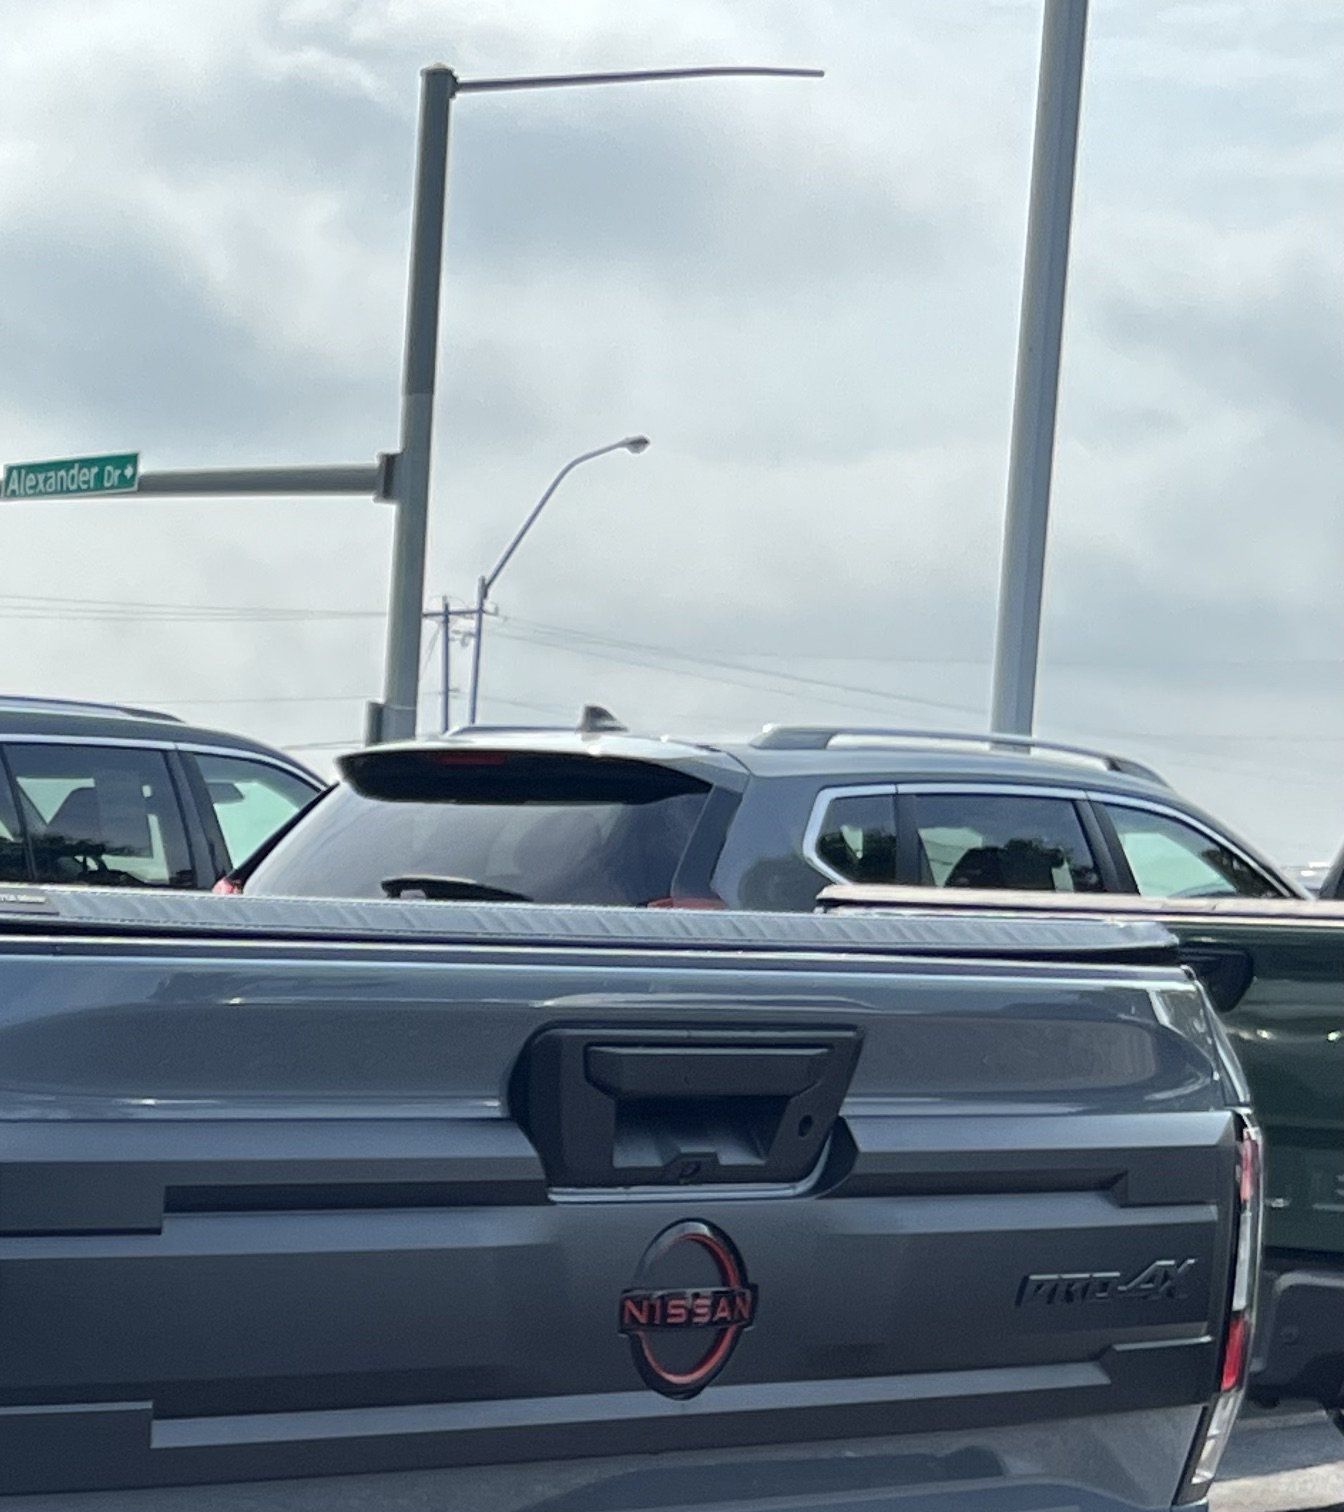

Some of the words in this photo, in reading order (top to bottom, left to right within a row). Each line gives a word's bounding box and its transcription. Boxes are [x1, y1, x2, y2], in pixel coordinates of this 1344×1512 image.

[7, 462, 99, 497] Alexander
[104, 467, 121, 488] Dr
[622, 1291, 753, 1327] NISSAN
